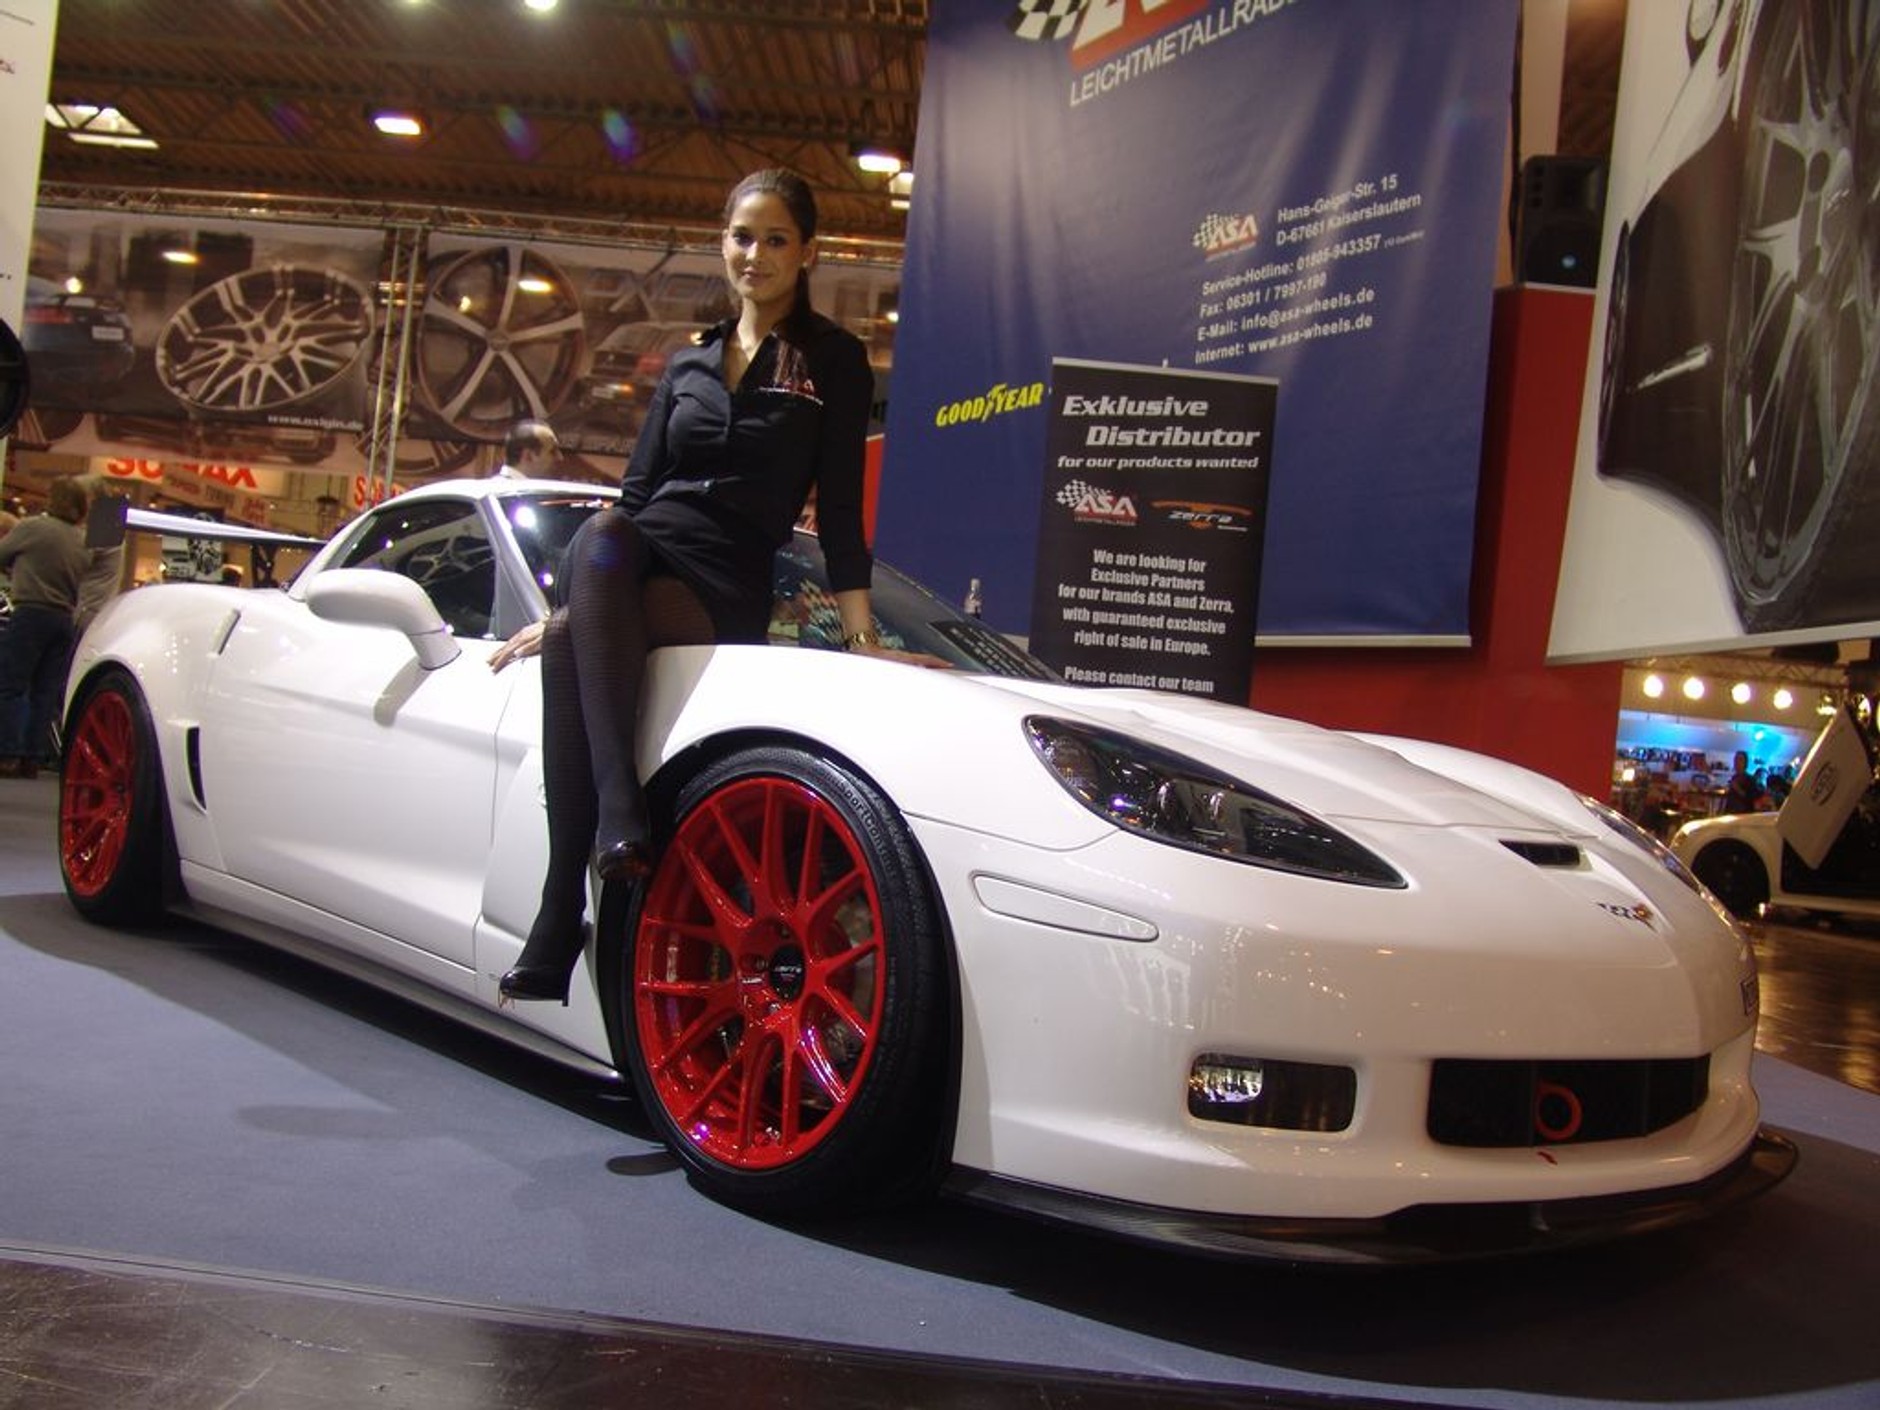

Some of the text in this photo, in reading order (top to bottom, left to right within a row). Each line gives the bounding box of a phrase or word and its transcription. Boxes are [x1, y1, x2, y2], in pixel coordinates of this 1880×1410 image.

[1381, 173, 1398, 192] 15
[1327, 193, 1421, 231] Kaiserslautern
[1202, 260, 1294, 296] Service-Hotline:
[1197, 287, 1376, 342] E-Mail: info@asa-wheels.de
[1200, 300, 1224, 318] Fax:
[1195, 314, 1373, 364] Internet: www.asa-wheels.de
[936, 382, 1044, 427] GOODYEAR
[1062, 396, 1208, 416] Exklusive
[1085, 426, 1260, 447] Distributor
[1057, 455, 1259, 470] for our products wanted
[1073, 492, 1138, 518] ASA
[1093, 549, 1207, 573] We are looking for
[1090, 567, 1206, 592] Exclusive Partners
[1057, 583, 1235, 613] for our brands ASA and Zerra,
[1062, 607, 1227, 635] with guaranteed exclusive
[1073, 630, 1212, 657] right of sale in Europe.
[1064, 665, 1214, 693] Please contact our team
